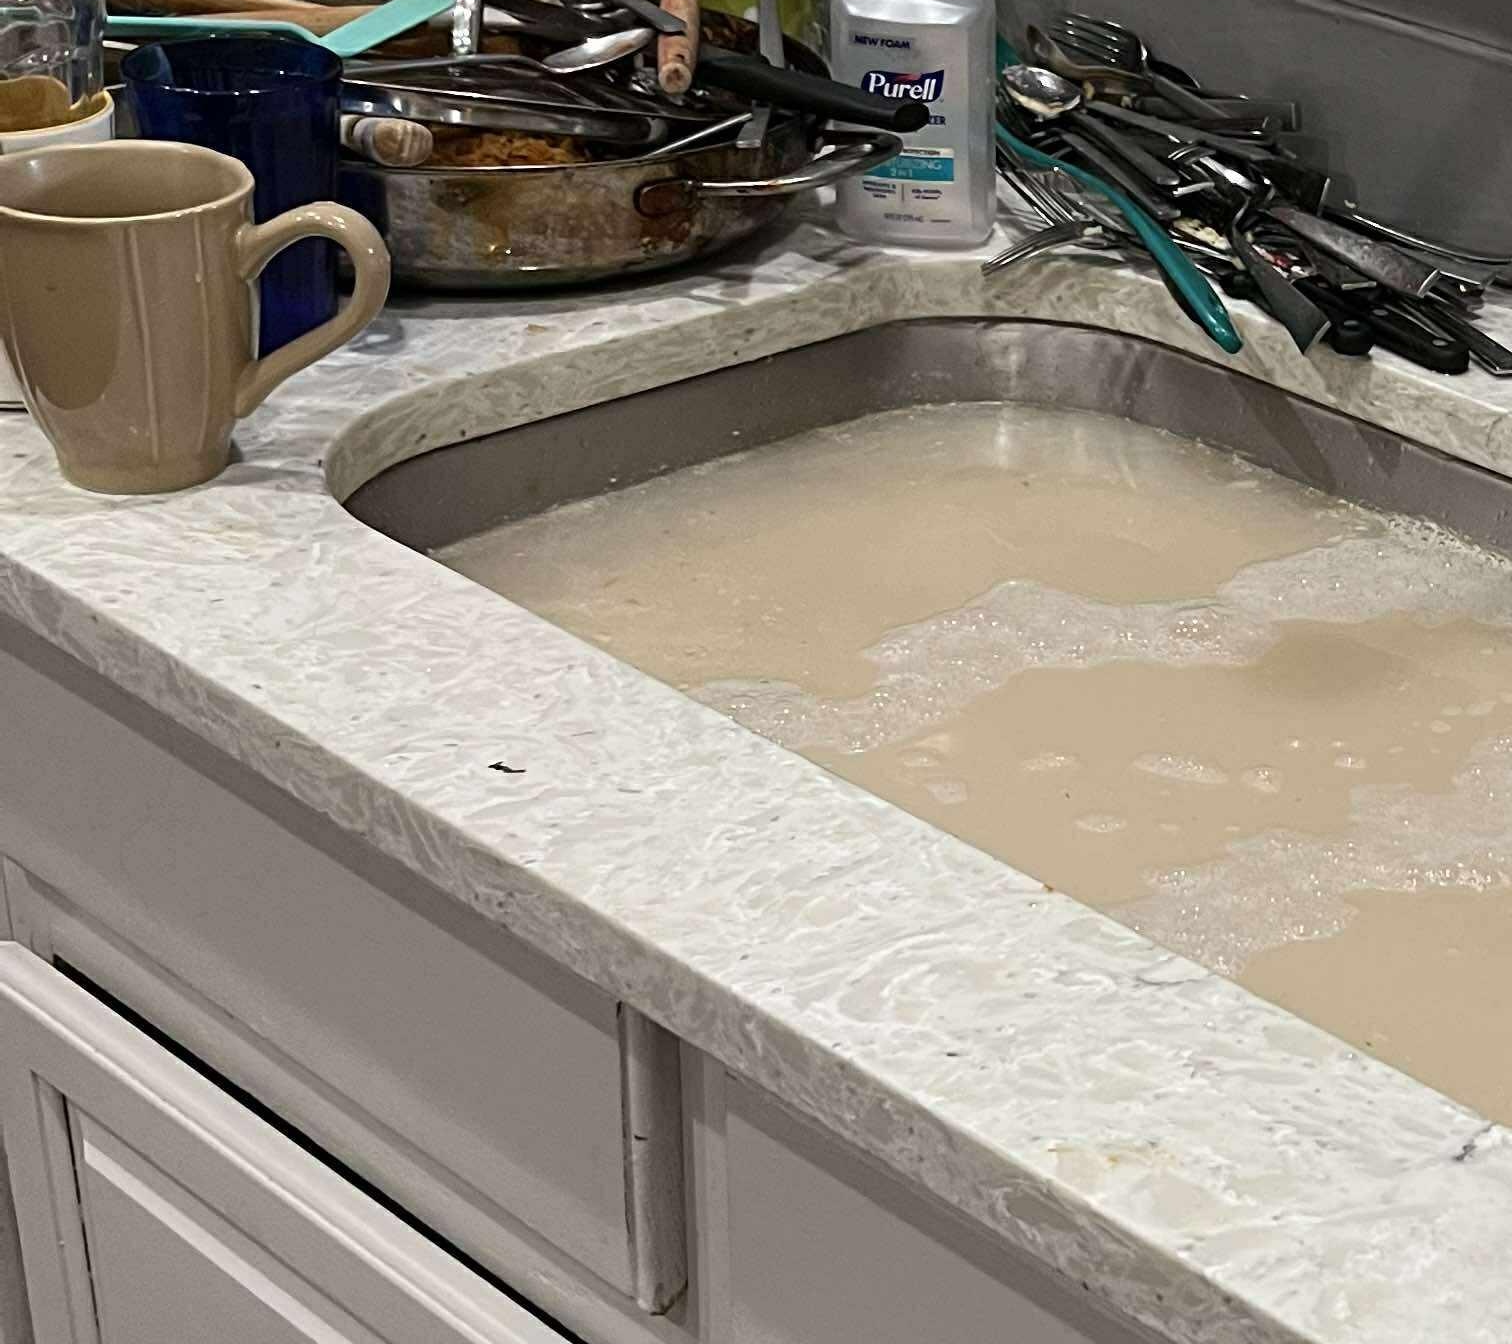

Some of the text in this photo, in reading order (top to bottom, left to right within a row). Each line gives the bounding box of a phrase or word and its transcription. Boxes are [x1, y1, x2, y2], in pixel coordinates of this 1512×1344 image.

[854, 34, 911, 49] NEW FOAM
[868, 73, 937, 100] Purell
